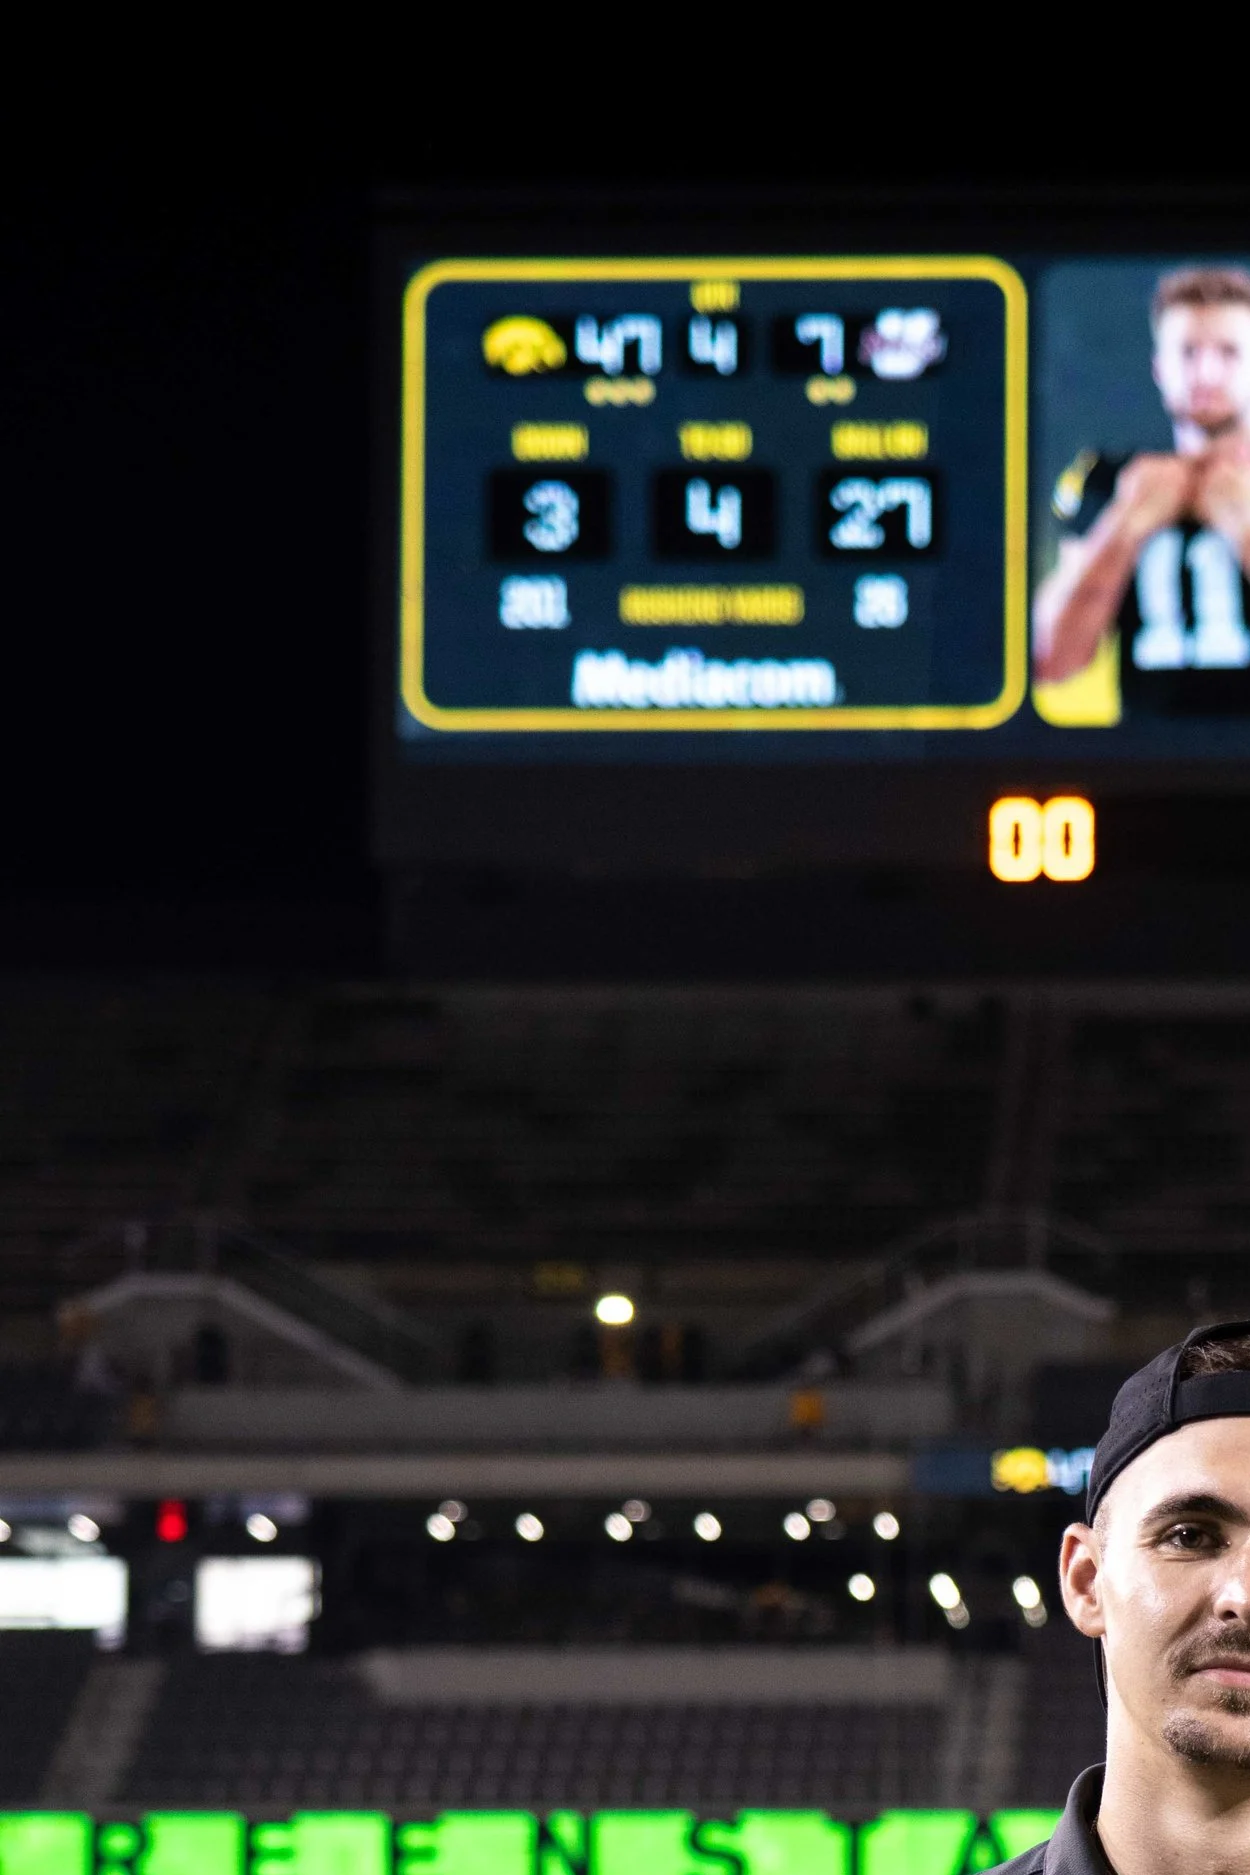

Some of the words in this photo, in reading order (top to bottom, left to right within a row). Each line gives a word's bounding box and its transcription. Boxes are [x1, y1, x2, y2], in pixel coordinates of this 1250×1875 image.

[574, 313, 662, 376] 47
[688, 313, 738, 376] 4
[795, 313, 845, 376] 7
[523, 479, 579, 552] 3
[686, 477, 741, 549] 4
[830, 477, 932, 549] 27
[571, 646, 836, 706] Mediacom
[989, 797, 1095, 882] 00
